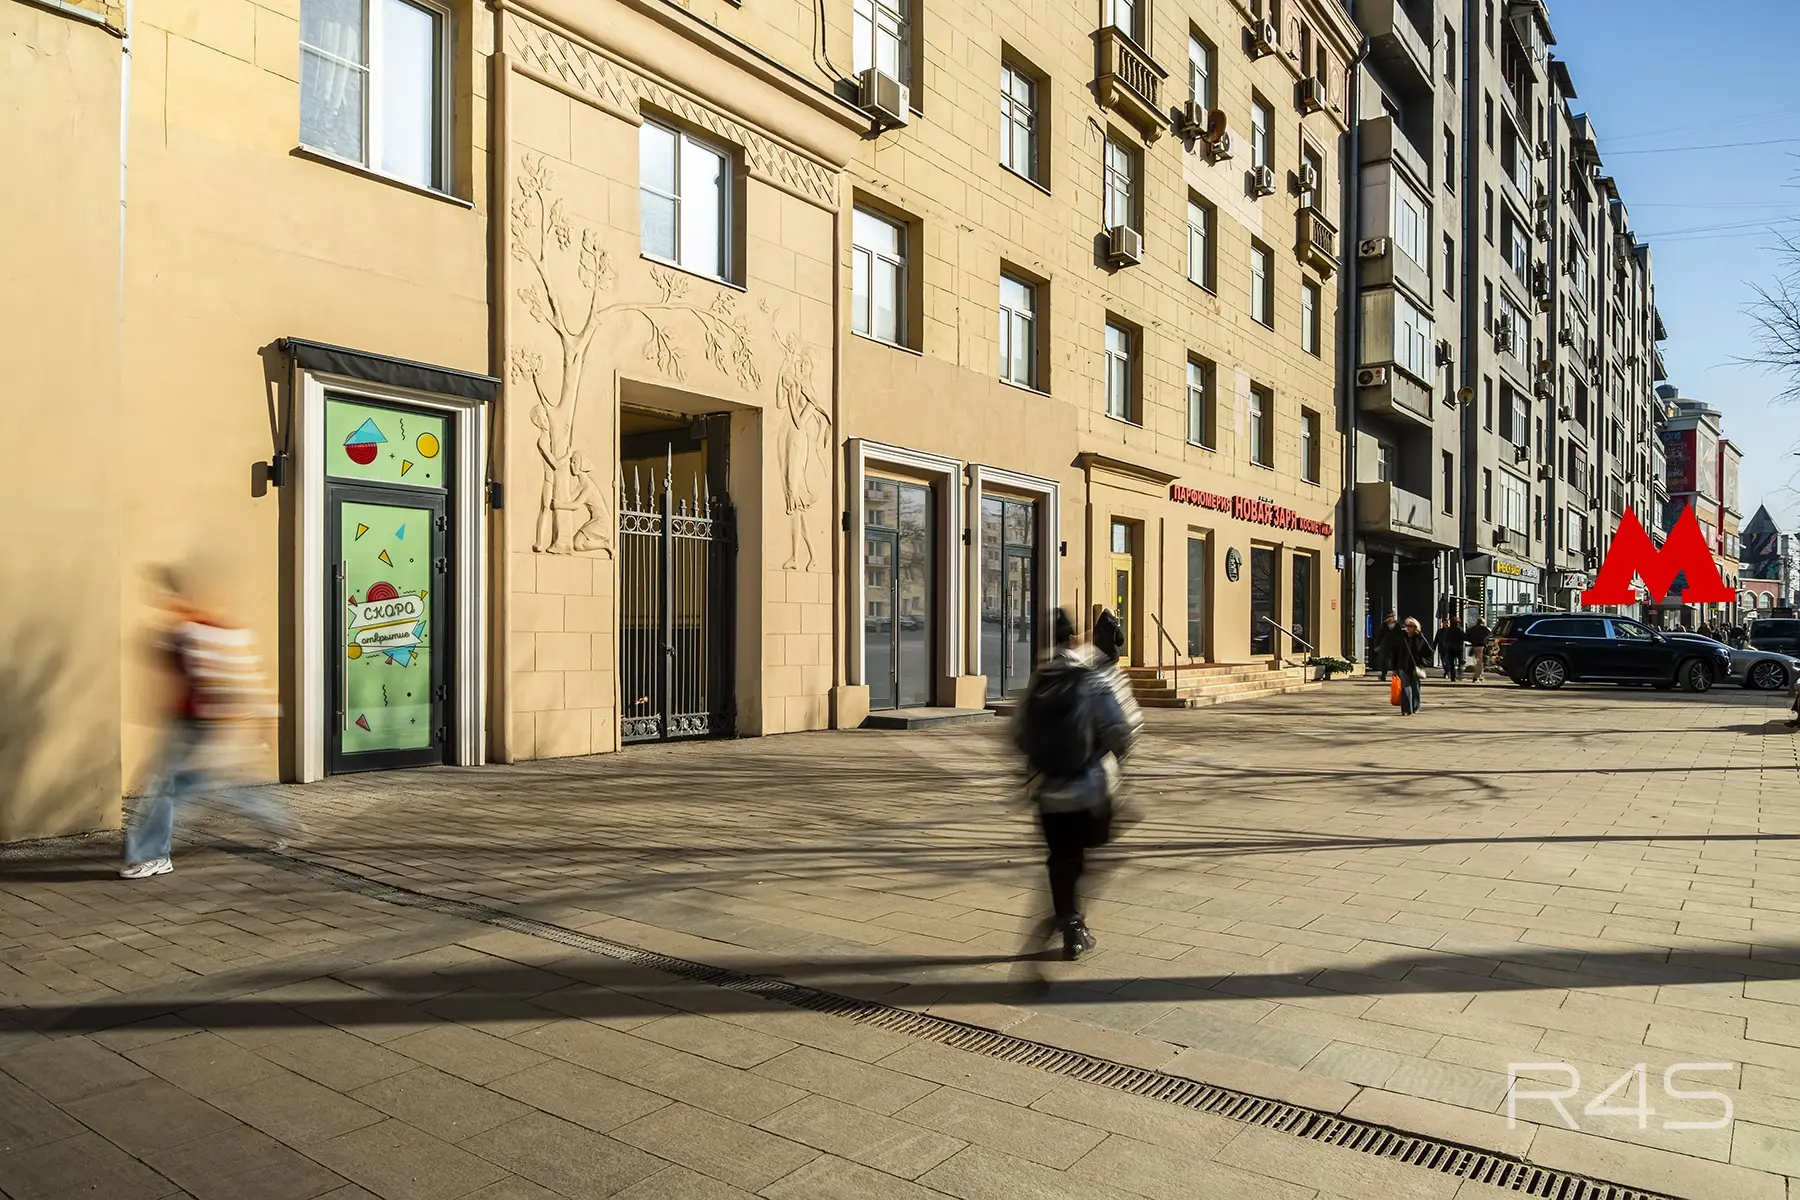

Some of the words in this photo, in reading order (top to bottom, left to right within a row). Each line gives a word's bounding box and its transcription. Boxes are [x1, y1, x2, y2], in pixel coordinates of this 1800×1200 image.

[1171, 484, 1230, 512] ПАРФЮМЕРИЯ
[1233, 496, 1271, 525] НОВАЯ
[1273, 505, 1297, 531] ЗАРЯ
[361, 631, 410, 645] открытие
